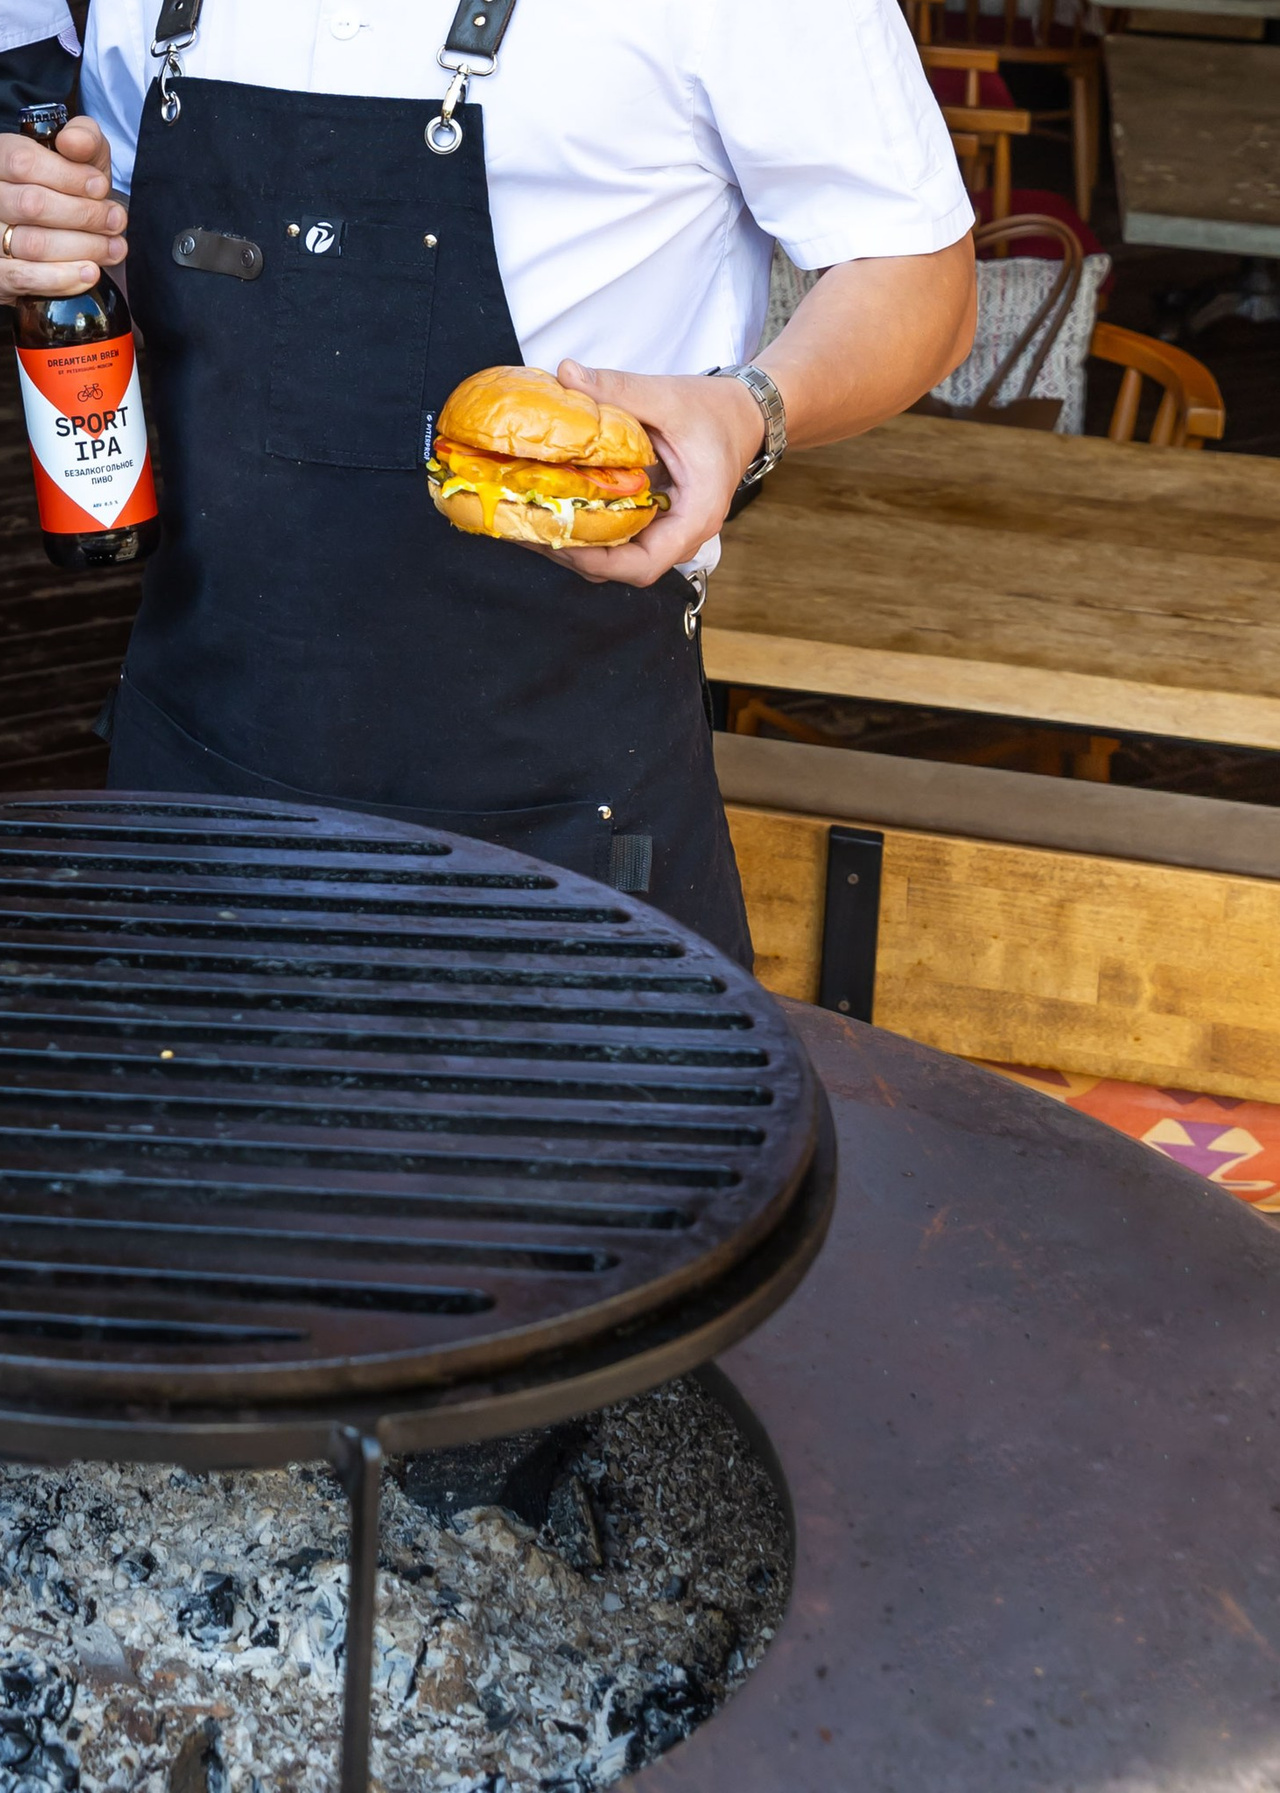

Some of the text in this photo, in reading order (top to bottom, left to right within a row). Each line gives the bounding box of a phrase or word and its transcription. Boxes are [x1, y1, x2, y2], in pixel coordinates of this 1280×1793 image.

[47, 349, 120, 367] DREAMTEAM BREW
[55, 406, 128, 437] SPORT
[74, 436, 122, 461] IPA
[64, 459, 134, 477] БЕЗАЛКОГОЛЬНОЕ
[91, 474, 113, 485] ПИВО
